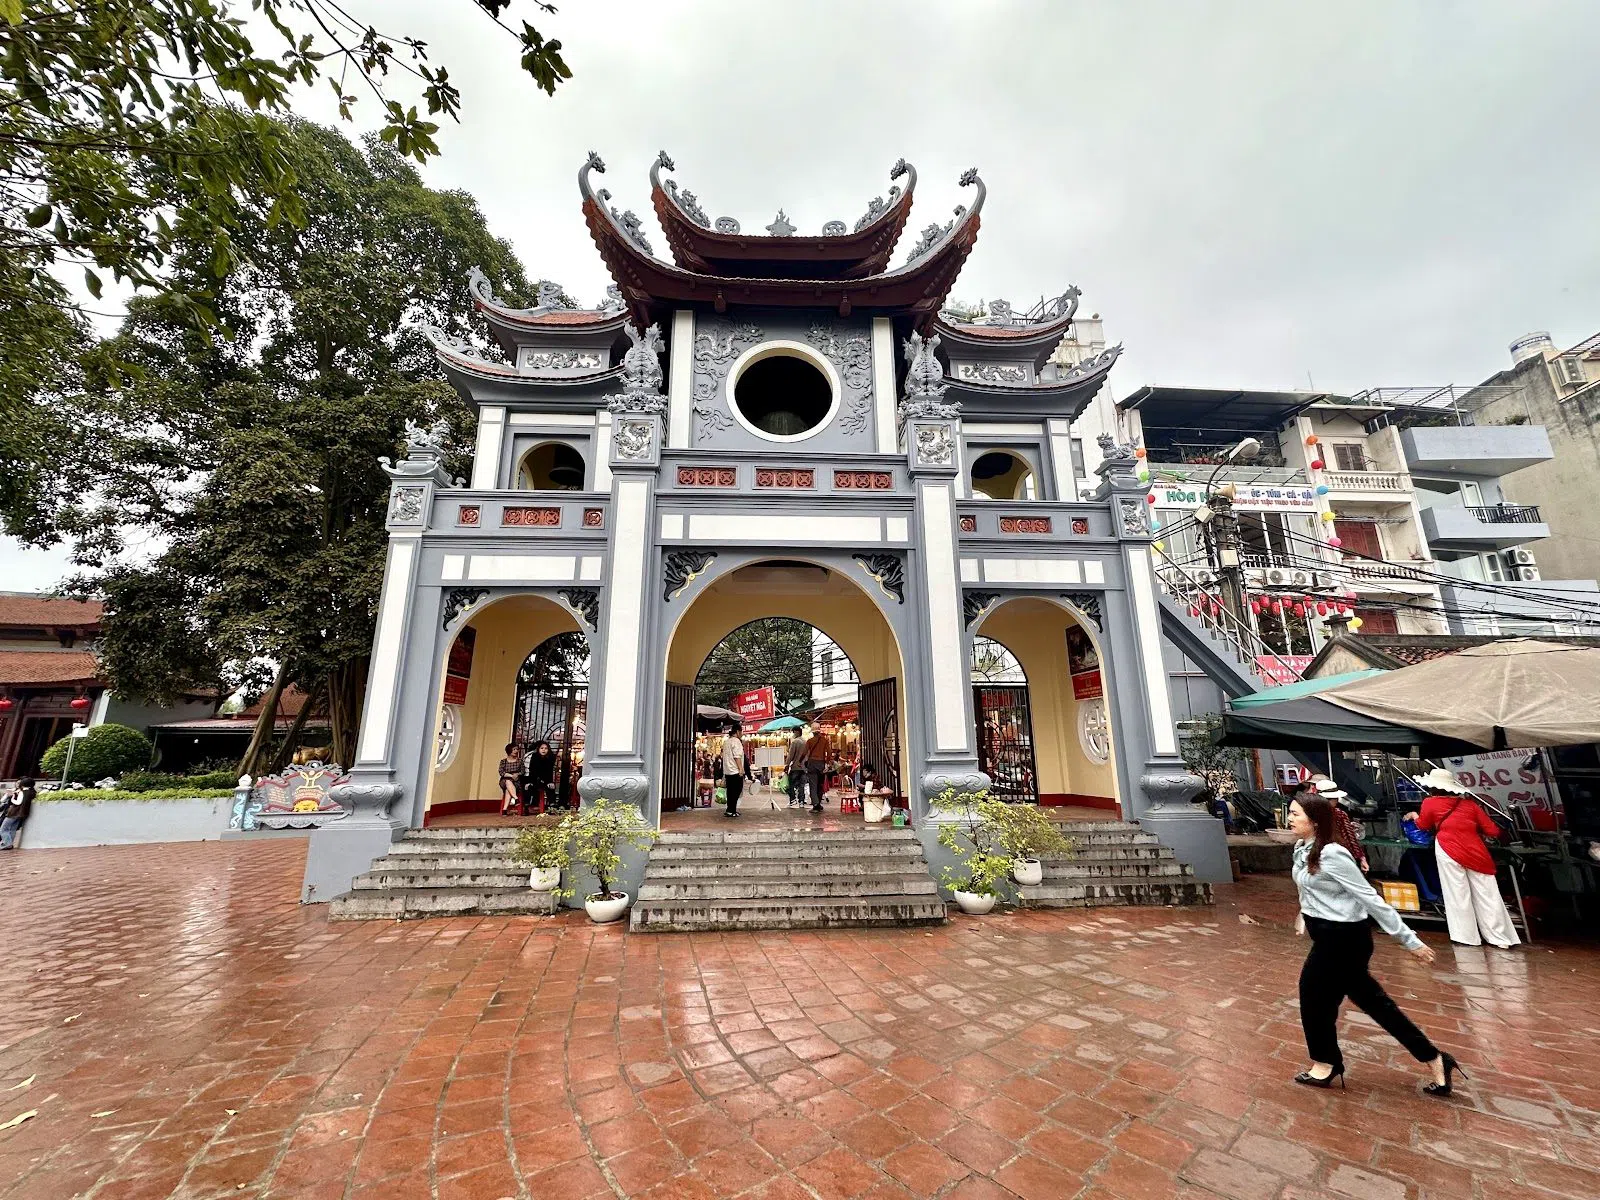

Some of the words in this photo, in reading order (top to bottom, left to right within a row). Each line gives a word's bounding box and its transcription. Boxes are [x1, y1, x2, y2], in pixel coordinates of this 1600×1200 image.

[1166, 488, 1197, 503] HÒA
[756, 701, 766, 711] NGA
[1457, 764, 1512, 790] ĐẶC
